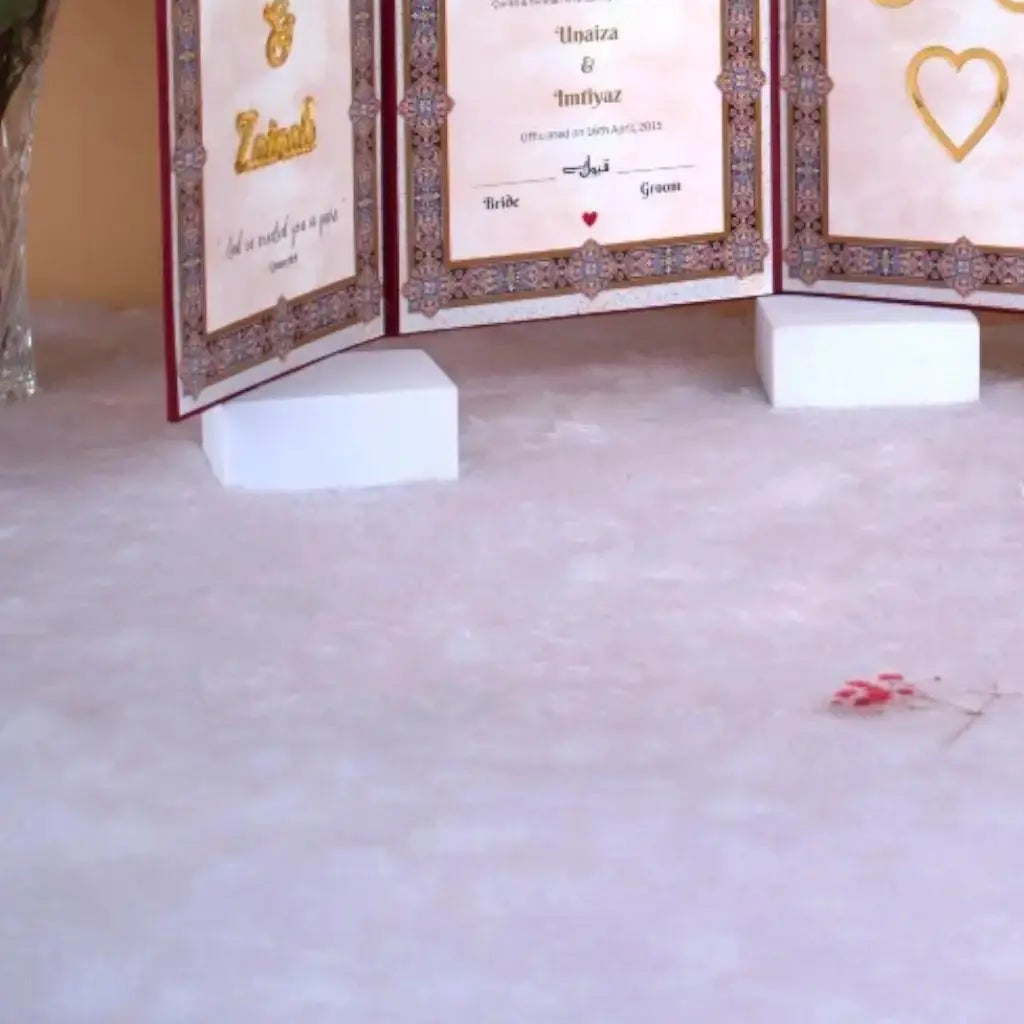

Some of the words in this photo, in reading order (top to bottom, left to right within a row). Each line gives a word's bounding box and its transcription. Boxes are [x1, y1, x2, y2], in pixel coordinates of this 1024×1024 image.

[580, 55, 596, 75] &
[639, 179, 682, 200] Groom
[481, 193, 521, 211] Bride
